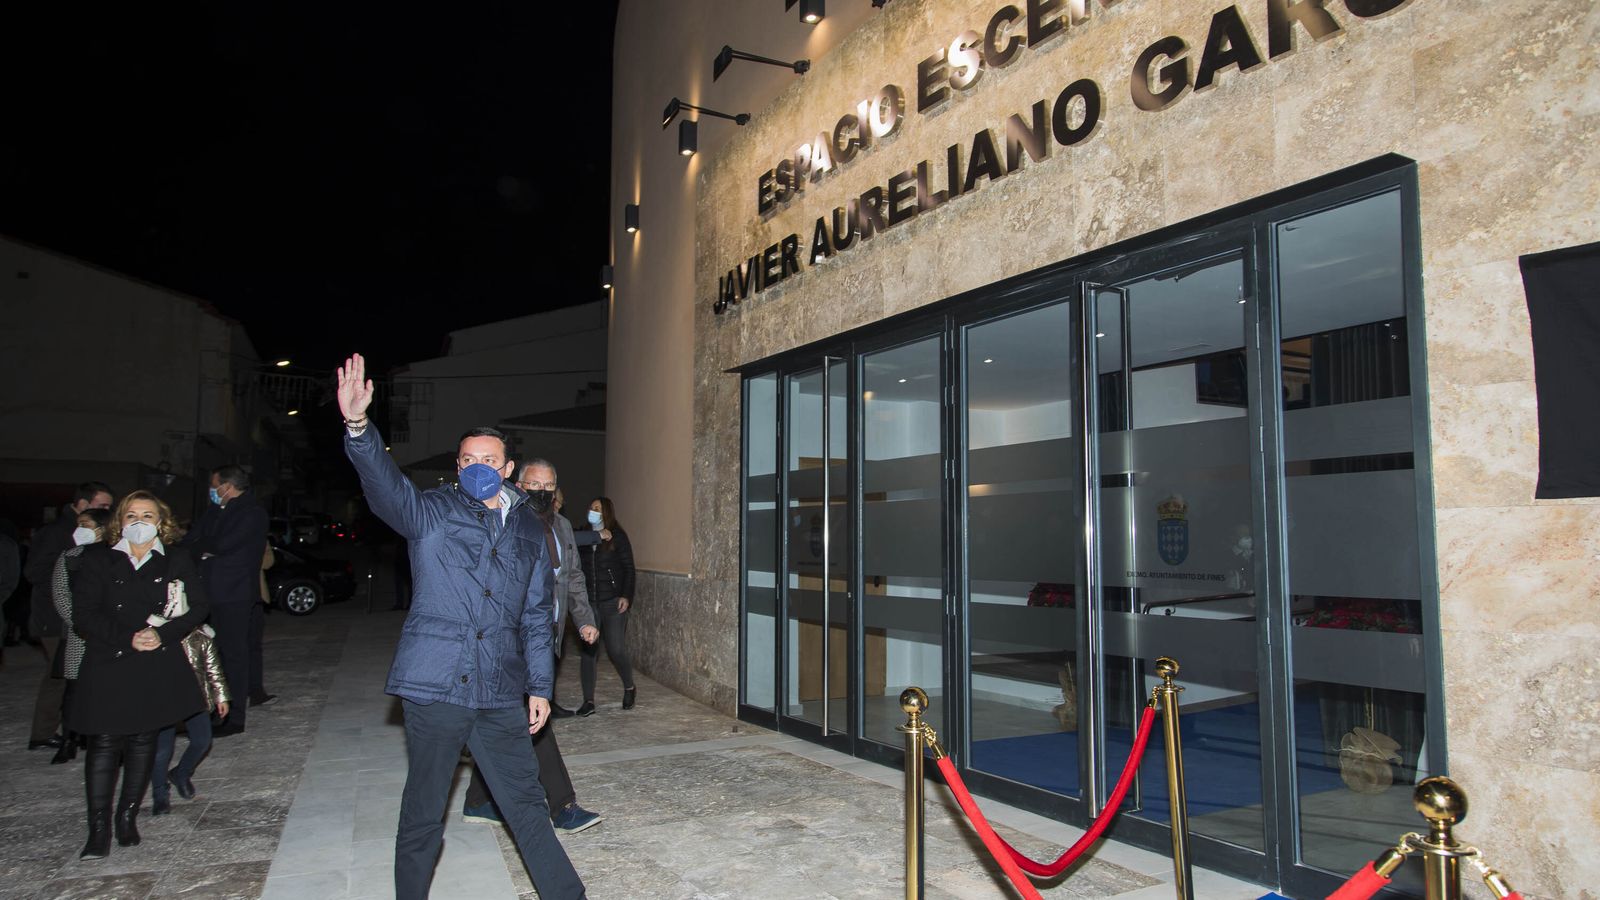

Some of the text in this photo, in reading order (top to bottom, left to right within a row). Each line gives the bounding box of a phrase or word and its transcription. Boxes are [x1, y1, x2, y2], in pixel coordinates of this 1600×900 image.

[713, 0, 1404, 315] JAVIER AURELIANO GAR
[758, 84, 903, 216] ESPACIO
